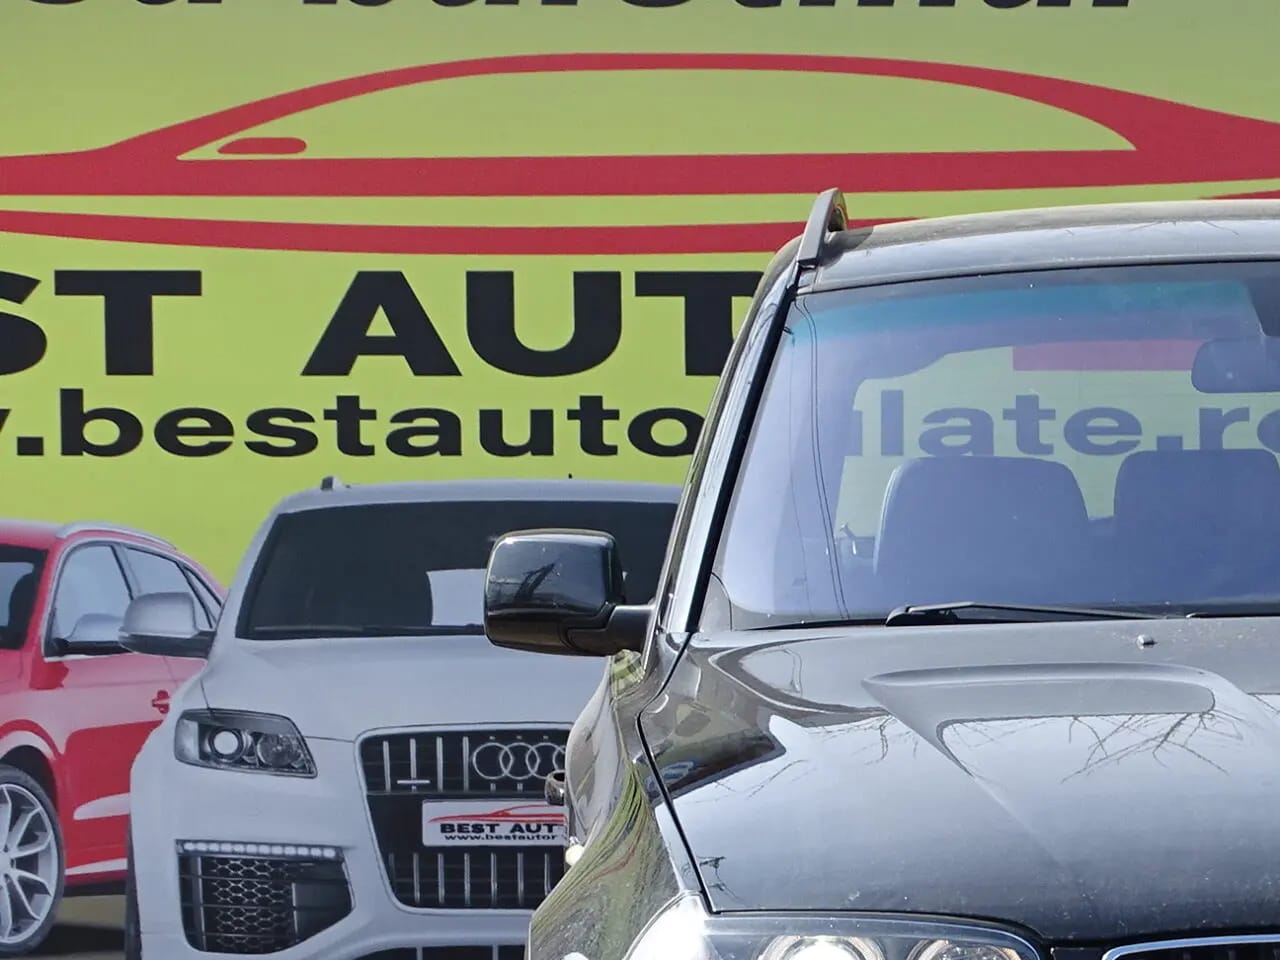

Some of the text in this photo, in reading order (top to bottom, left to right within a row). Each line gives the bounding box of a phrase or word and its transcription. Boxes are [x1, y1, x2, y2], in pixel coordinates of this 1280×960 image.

[301, 270, 765, 378] AUT
[0, 388, 706, 458] .bestauto
[440, 823, 500, 834] BEST
